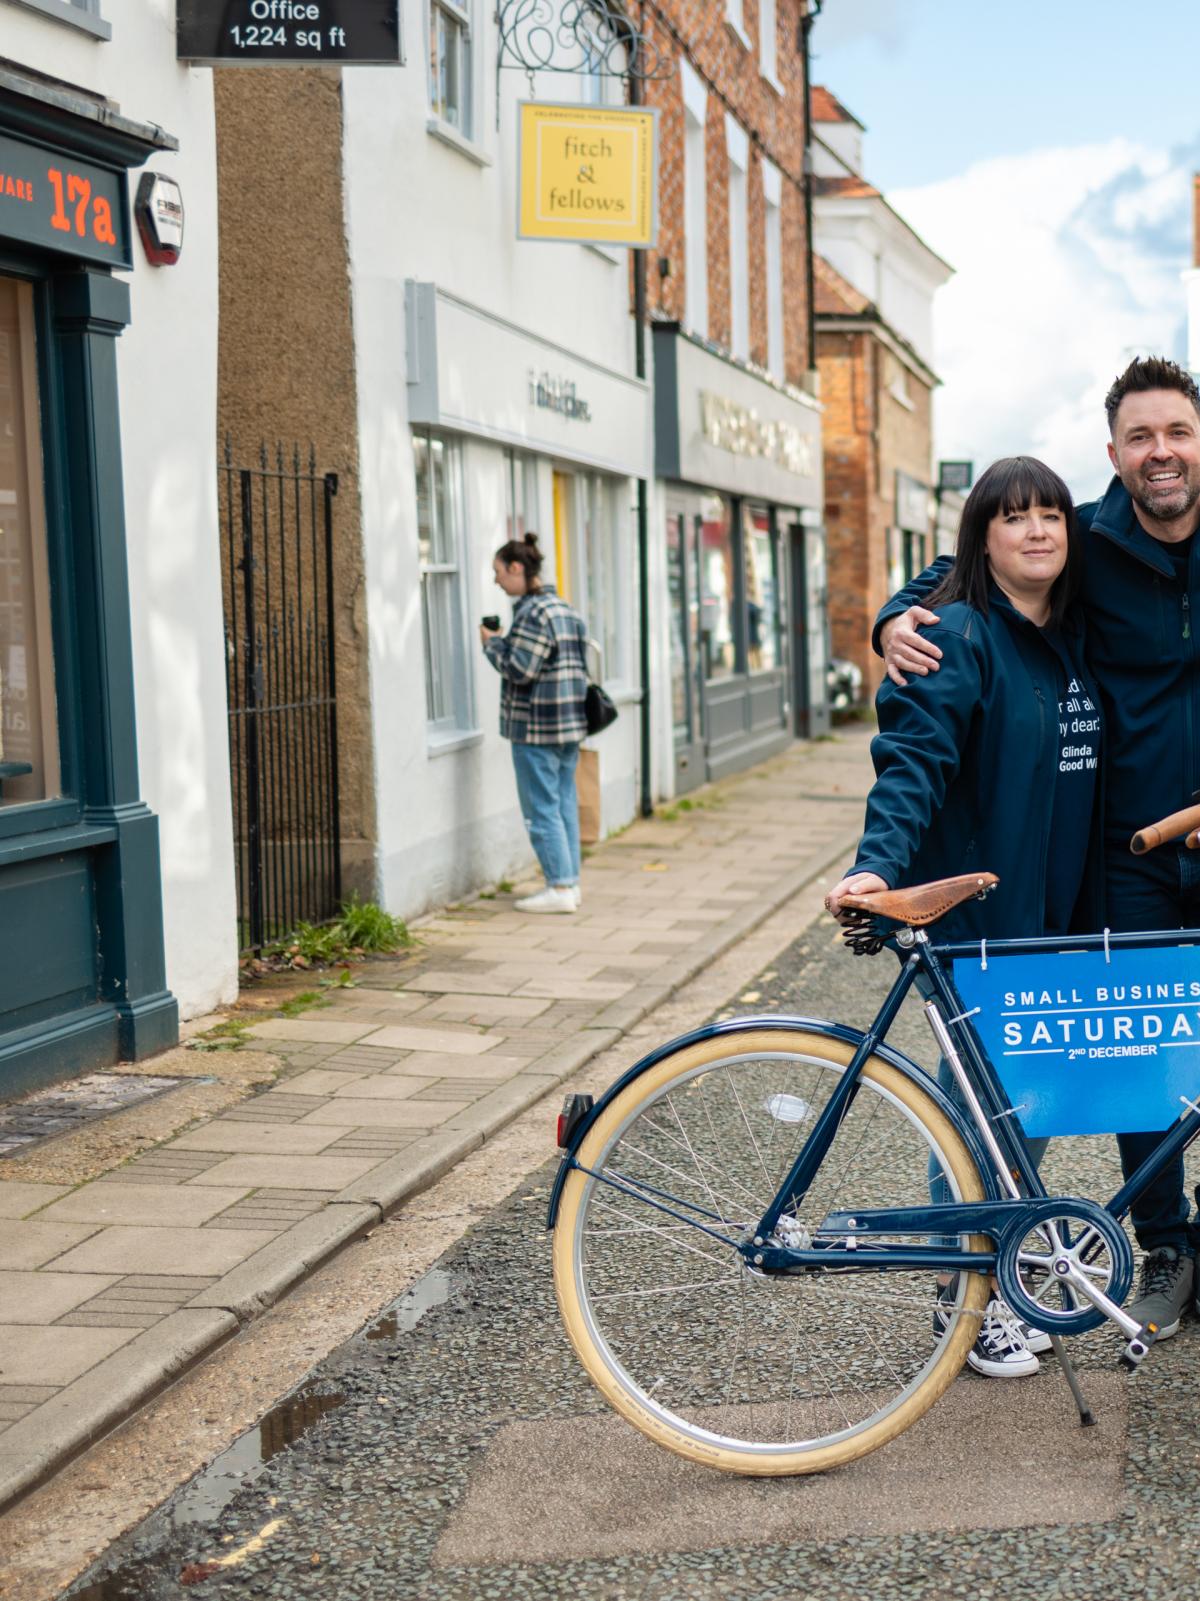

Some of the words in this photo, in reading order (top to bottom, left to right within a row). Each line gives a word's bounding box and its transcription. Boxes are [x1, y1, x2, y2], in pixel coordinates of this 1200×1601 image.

[250, 0, 320, 20] Office
[230, 25, 287, 48] 1,224
[295, 30, 322, 50] sq
[329, 26, 346, 47] ft
[564, 136, 613, 160] fitch
[577, 164, 598, 184] &
[48, 167, 117, 246] 17a
[549, 187, 626, 212] fellows
[1067, 698, 1081, 713] all
[1062, 745, 1093, 758] Glinda
[1059, 759, 1083, 772] Good
[1004, 989, 1083, 1007] SMALL
[1068, 1047, 1086, 1060] 2ND
[1088, 1045, 1158, 1059] DECEMBER
